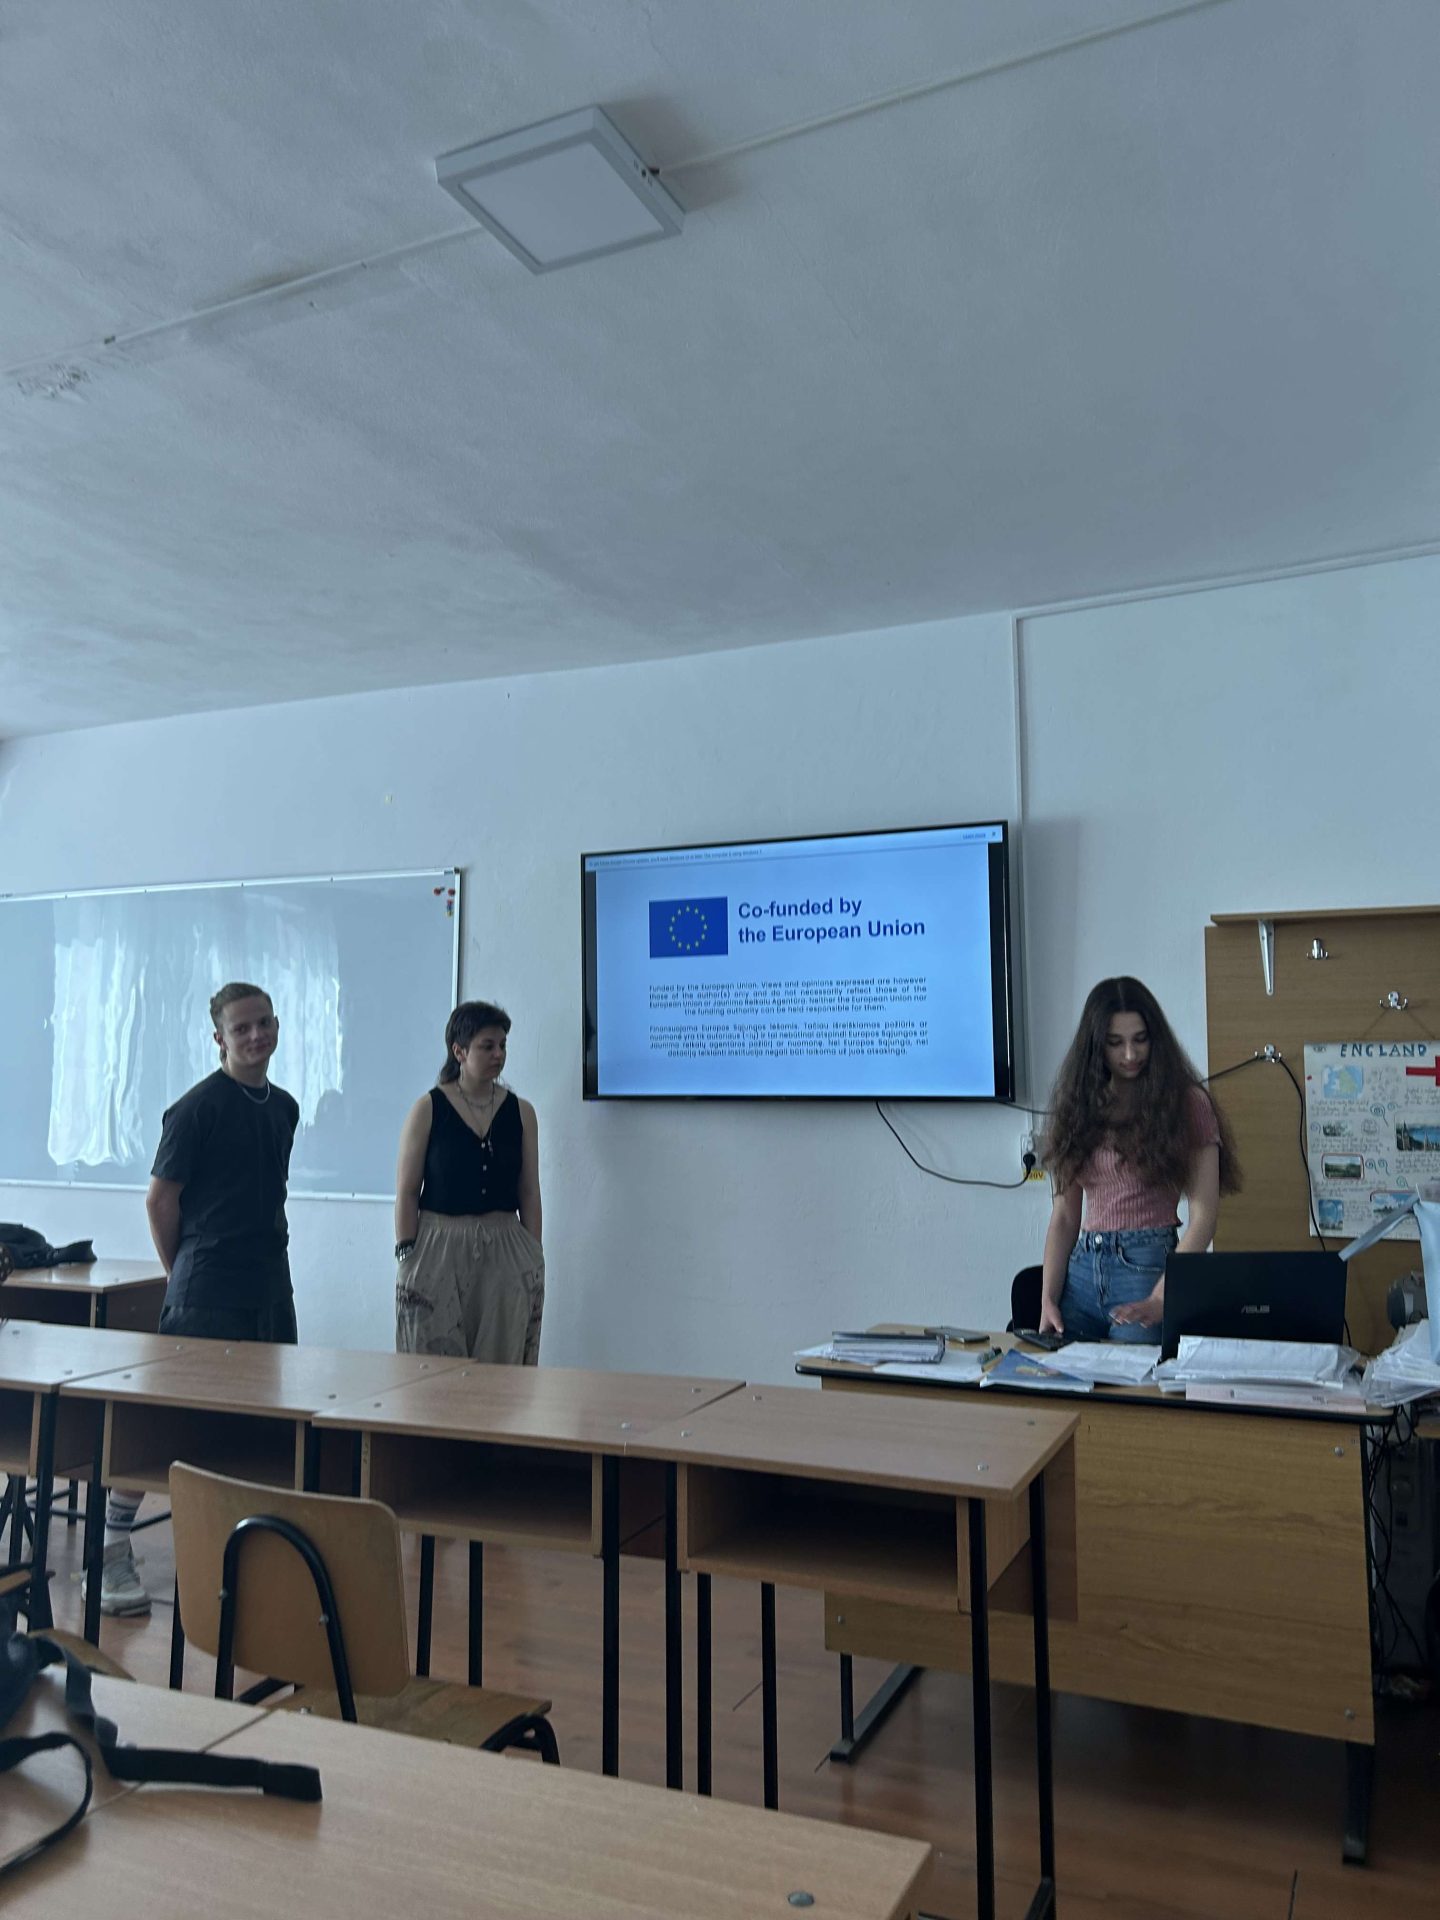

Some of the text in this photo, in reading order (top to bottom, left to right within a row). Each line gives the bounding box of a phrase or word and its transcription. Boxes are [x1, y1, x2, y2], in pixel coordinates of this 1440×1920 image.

[738, 896, 862, 919] Co-funded by
[738, 919, 925, 944] the European Union
[1340, 1043, 1428, 1058] ENGLAND
